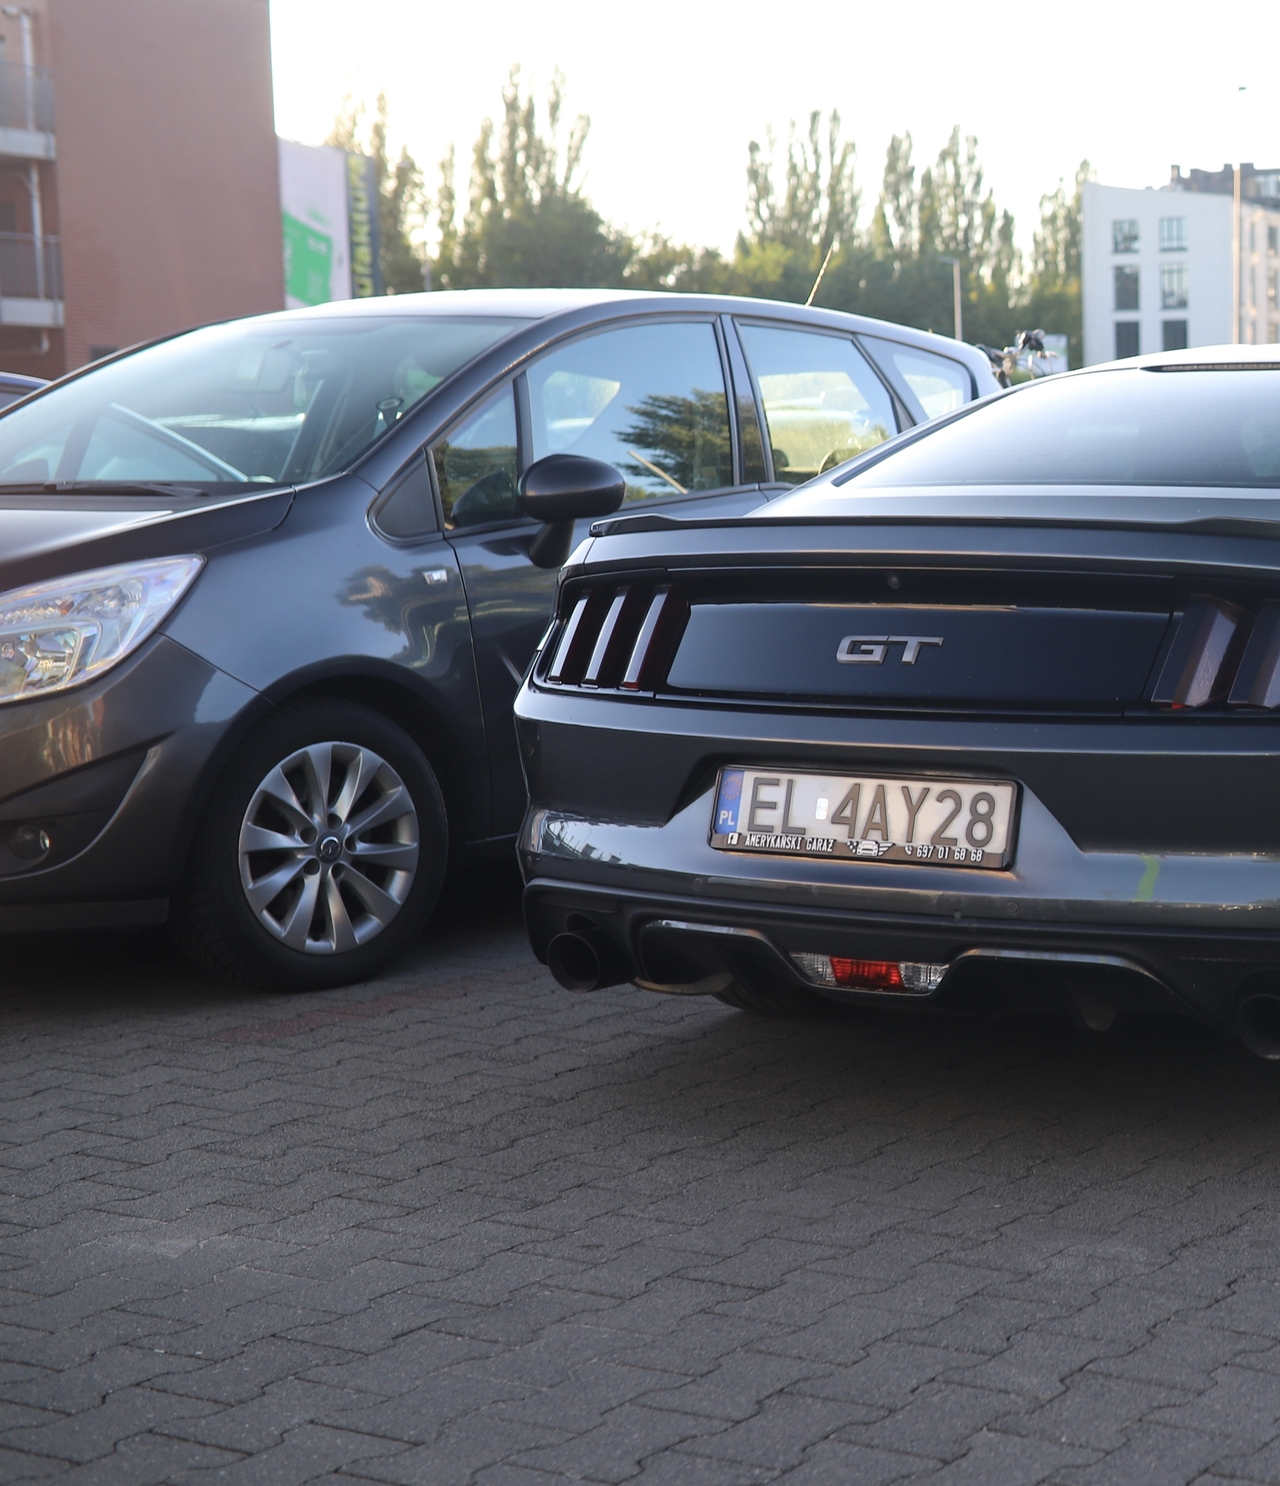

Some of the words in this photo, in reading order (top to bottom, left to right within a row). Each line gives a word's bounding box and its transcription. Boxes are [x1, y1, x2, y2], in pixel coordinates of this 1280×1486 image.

[836, 635, 945, 665] GT
[718, 809, 735, 826] PL
[747, 777, 807, 836] EL
[830, 783, 996, 848] 4AY28
[916, 845, 934, 858] 697
[938, 847, 950, 859] 01
[954, 848, 966, 861] 68
[970, 849, 983, 862] 68
